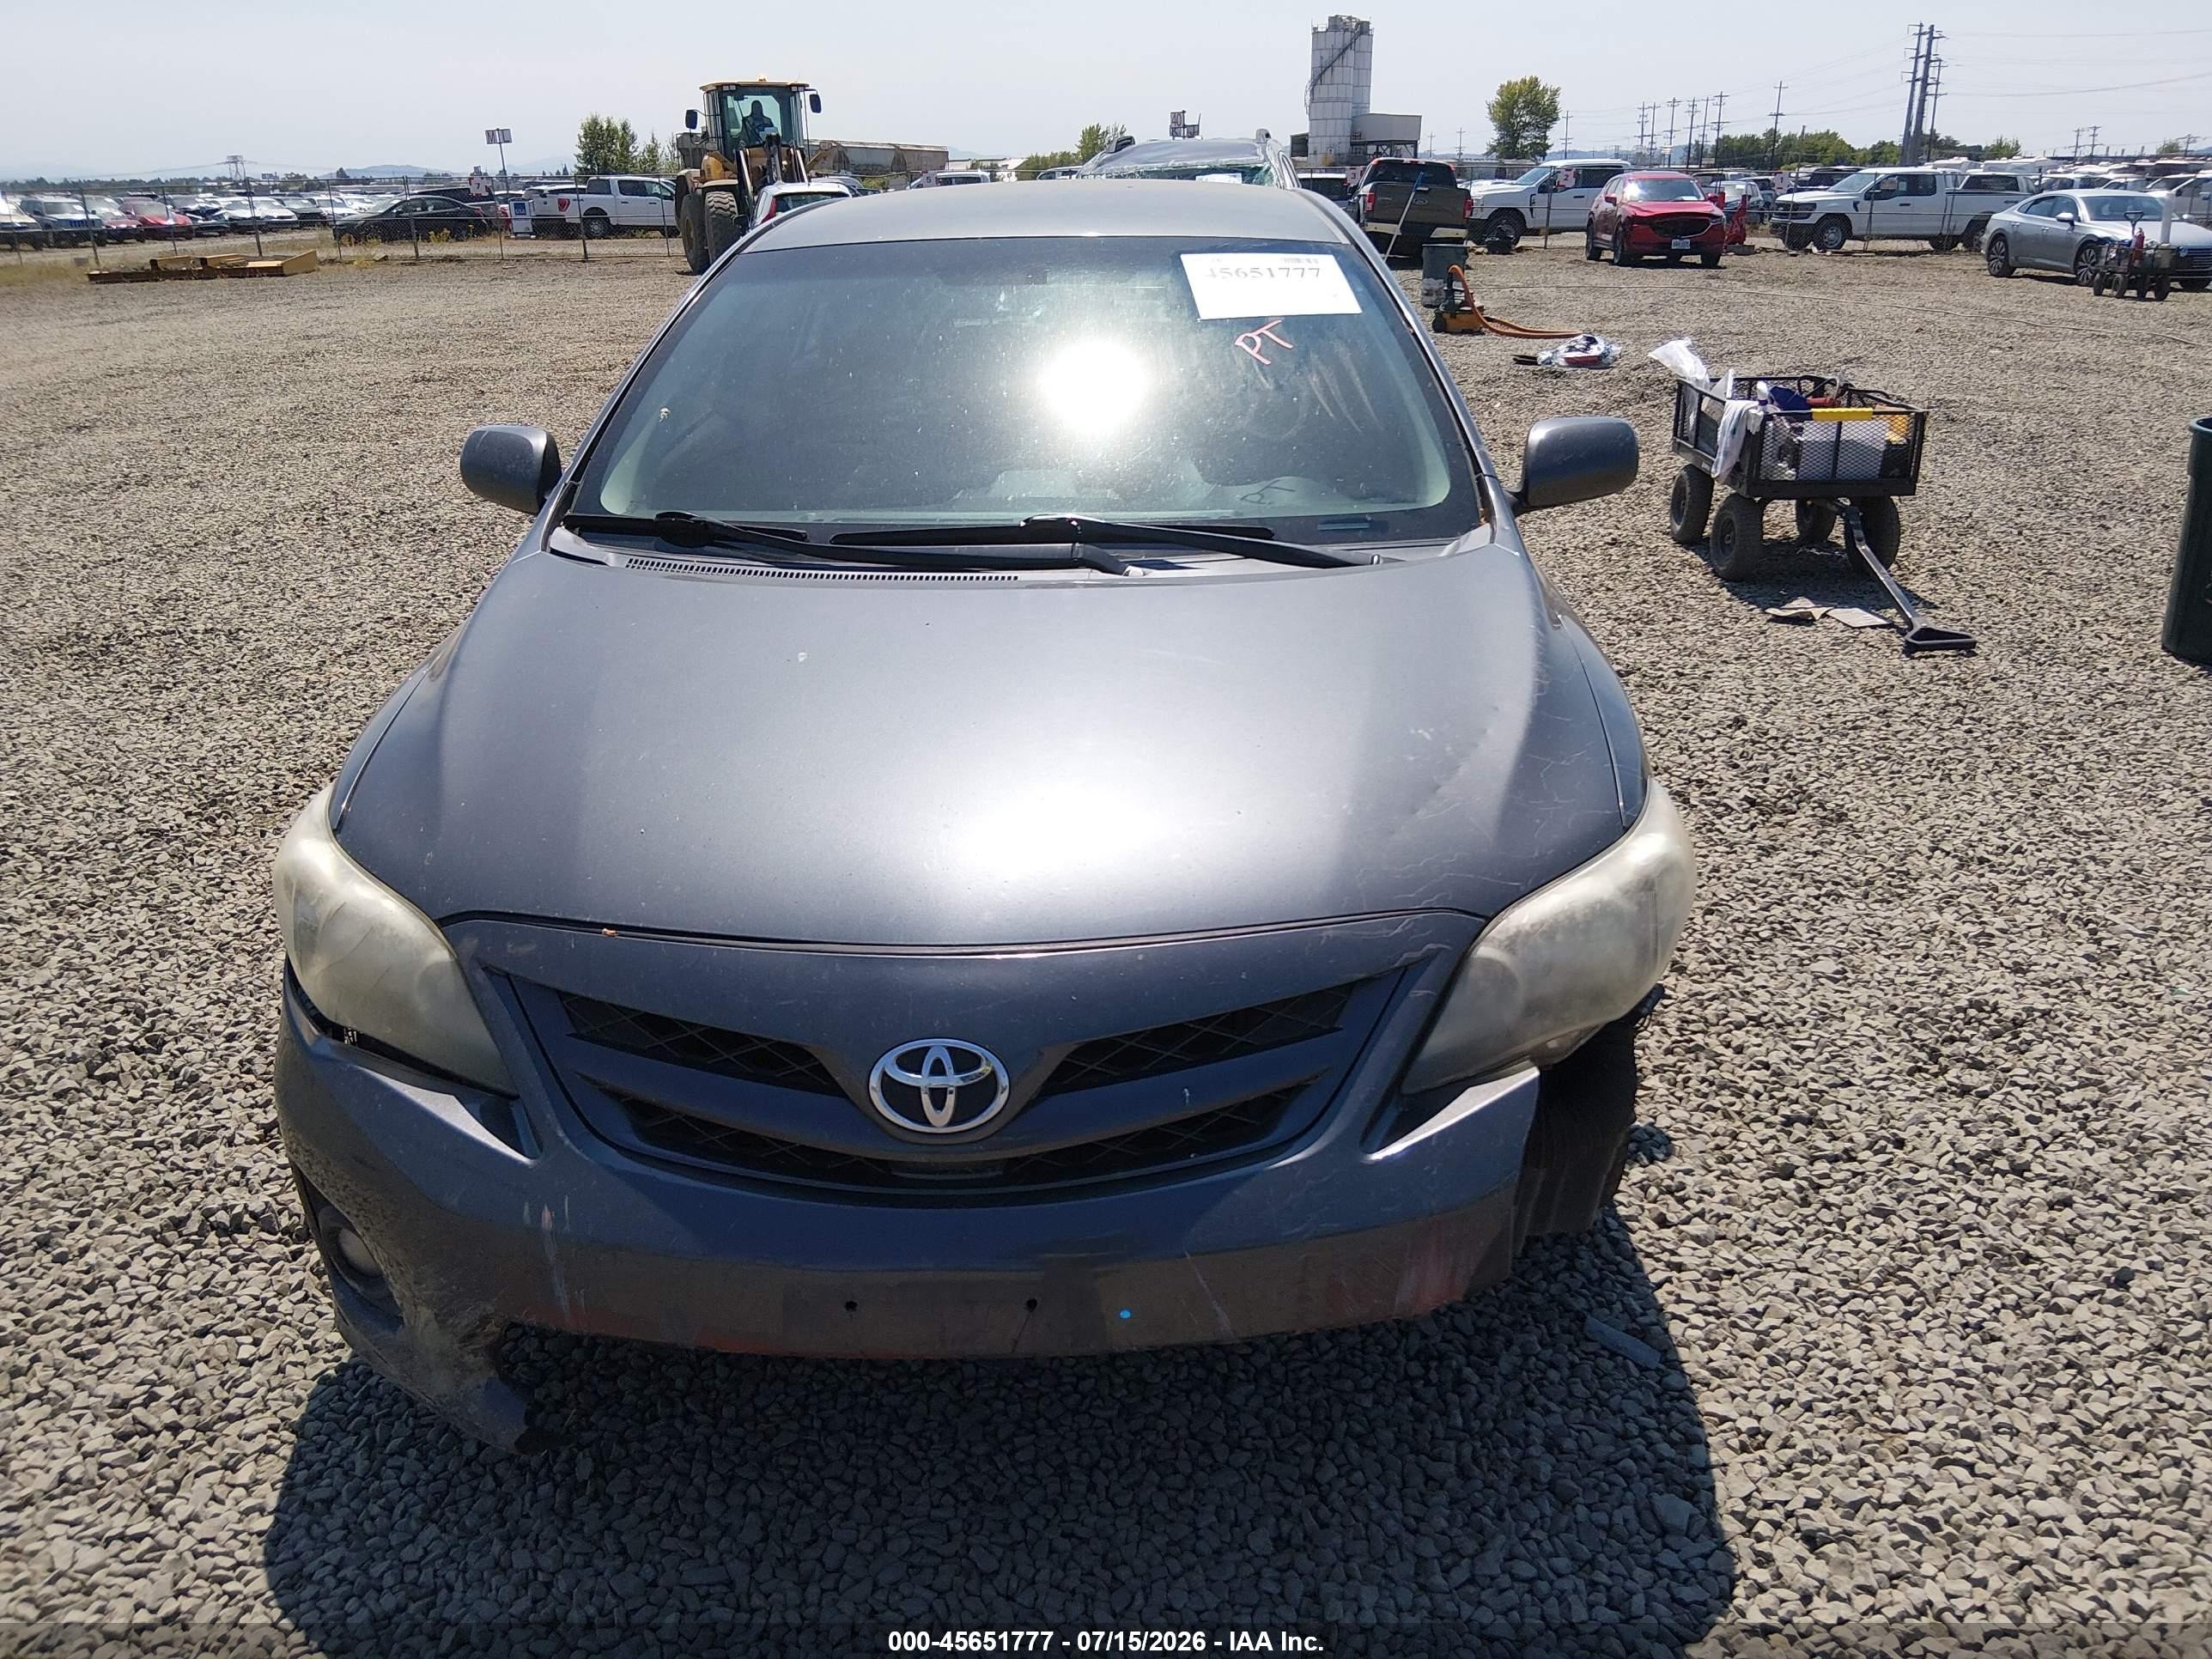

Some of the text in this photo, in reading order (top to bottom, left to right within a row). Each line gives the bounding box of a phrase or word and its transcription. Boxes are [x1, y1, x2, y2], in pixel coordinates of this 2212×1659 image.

[1171, 113, 1182, 126] 40
[487, 131, 497, 144] M
[1171, 127, 1178, 137] K
[1235, 320, 1294, 365] PT
